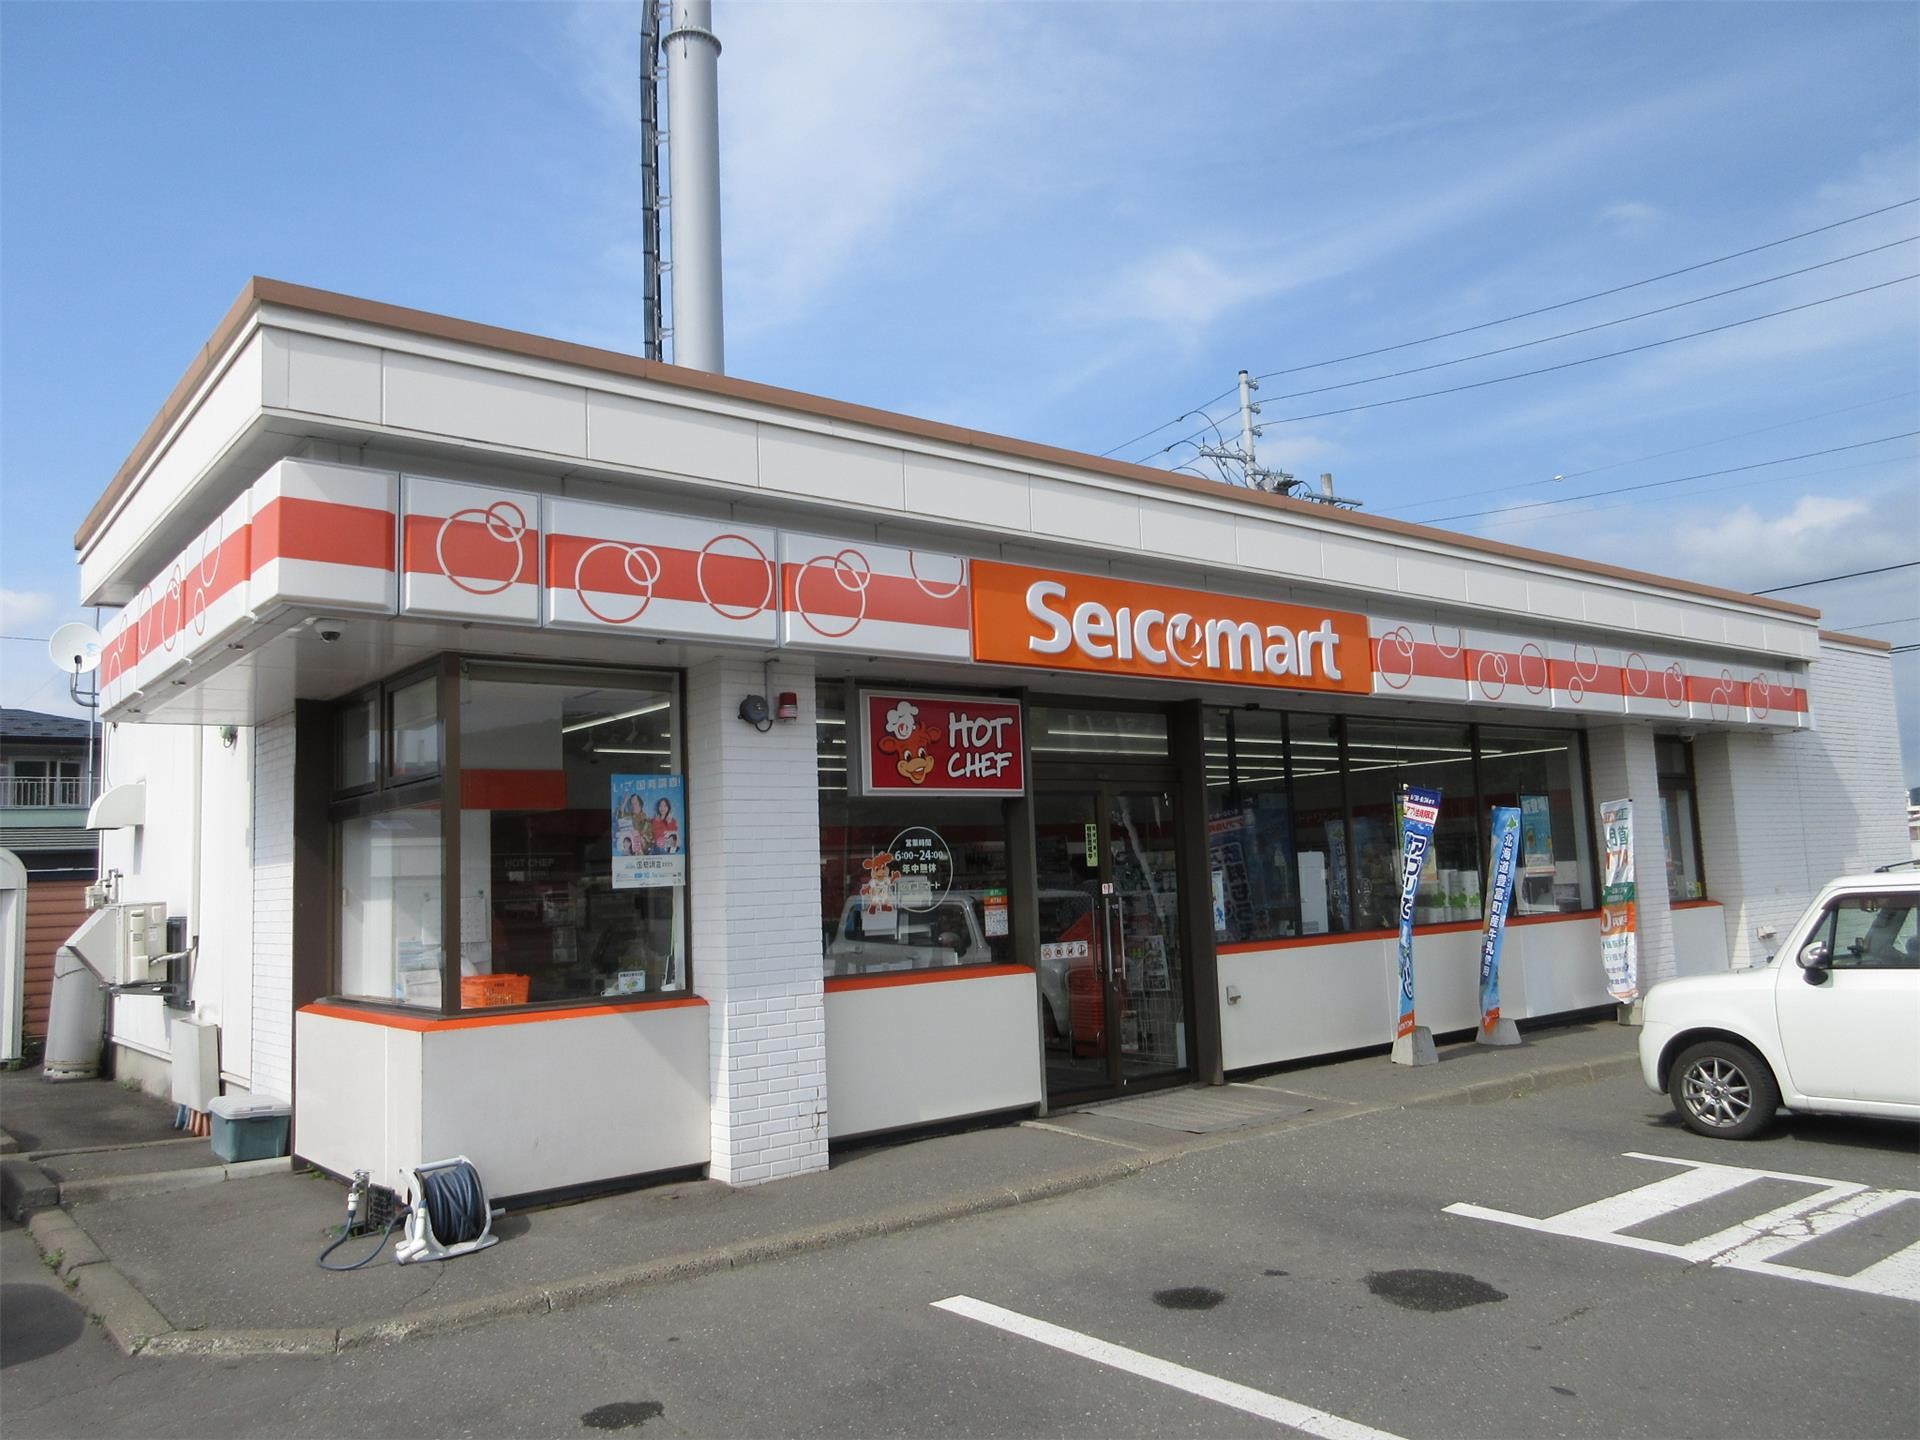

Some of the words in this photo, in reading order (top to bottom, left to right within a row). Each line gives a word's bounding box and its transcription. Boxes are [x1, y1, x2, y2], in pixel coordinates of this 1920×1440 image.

[1025, 580, 1342, 681] Seicomart
[948, 711, 1014, 749] HOT
[947, 751, 1013, 778] CHEF
[905, 838, 932, 848] 営業時間
[902, 863, 937, 874] 年中無休
